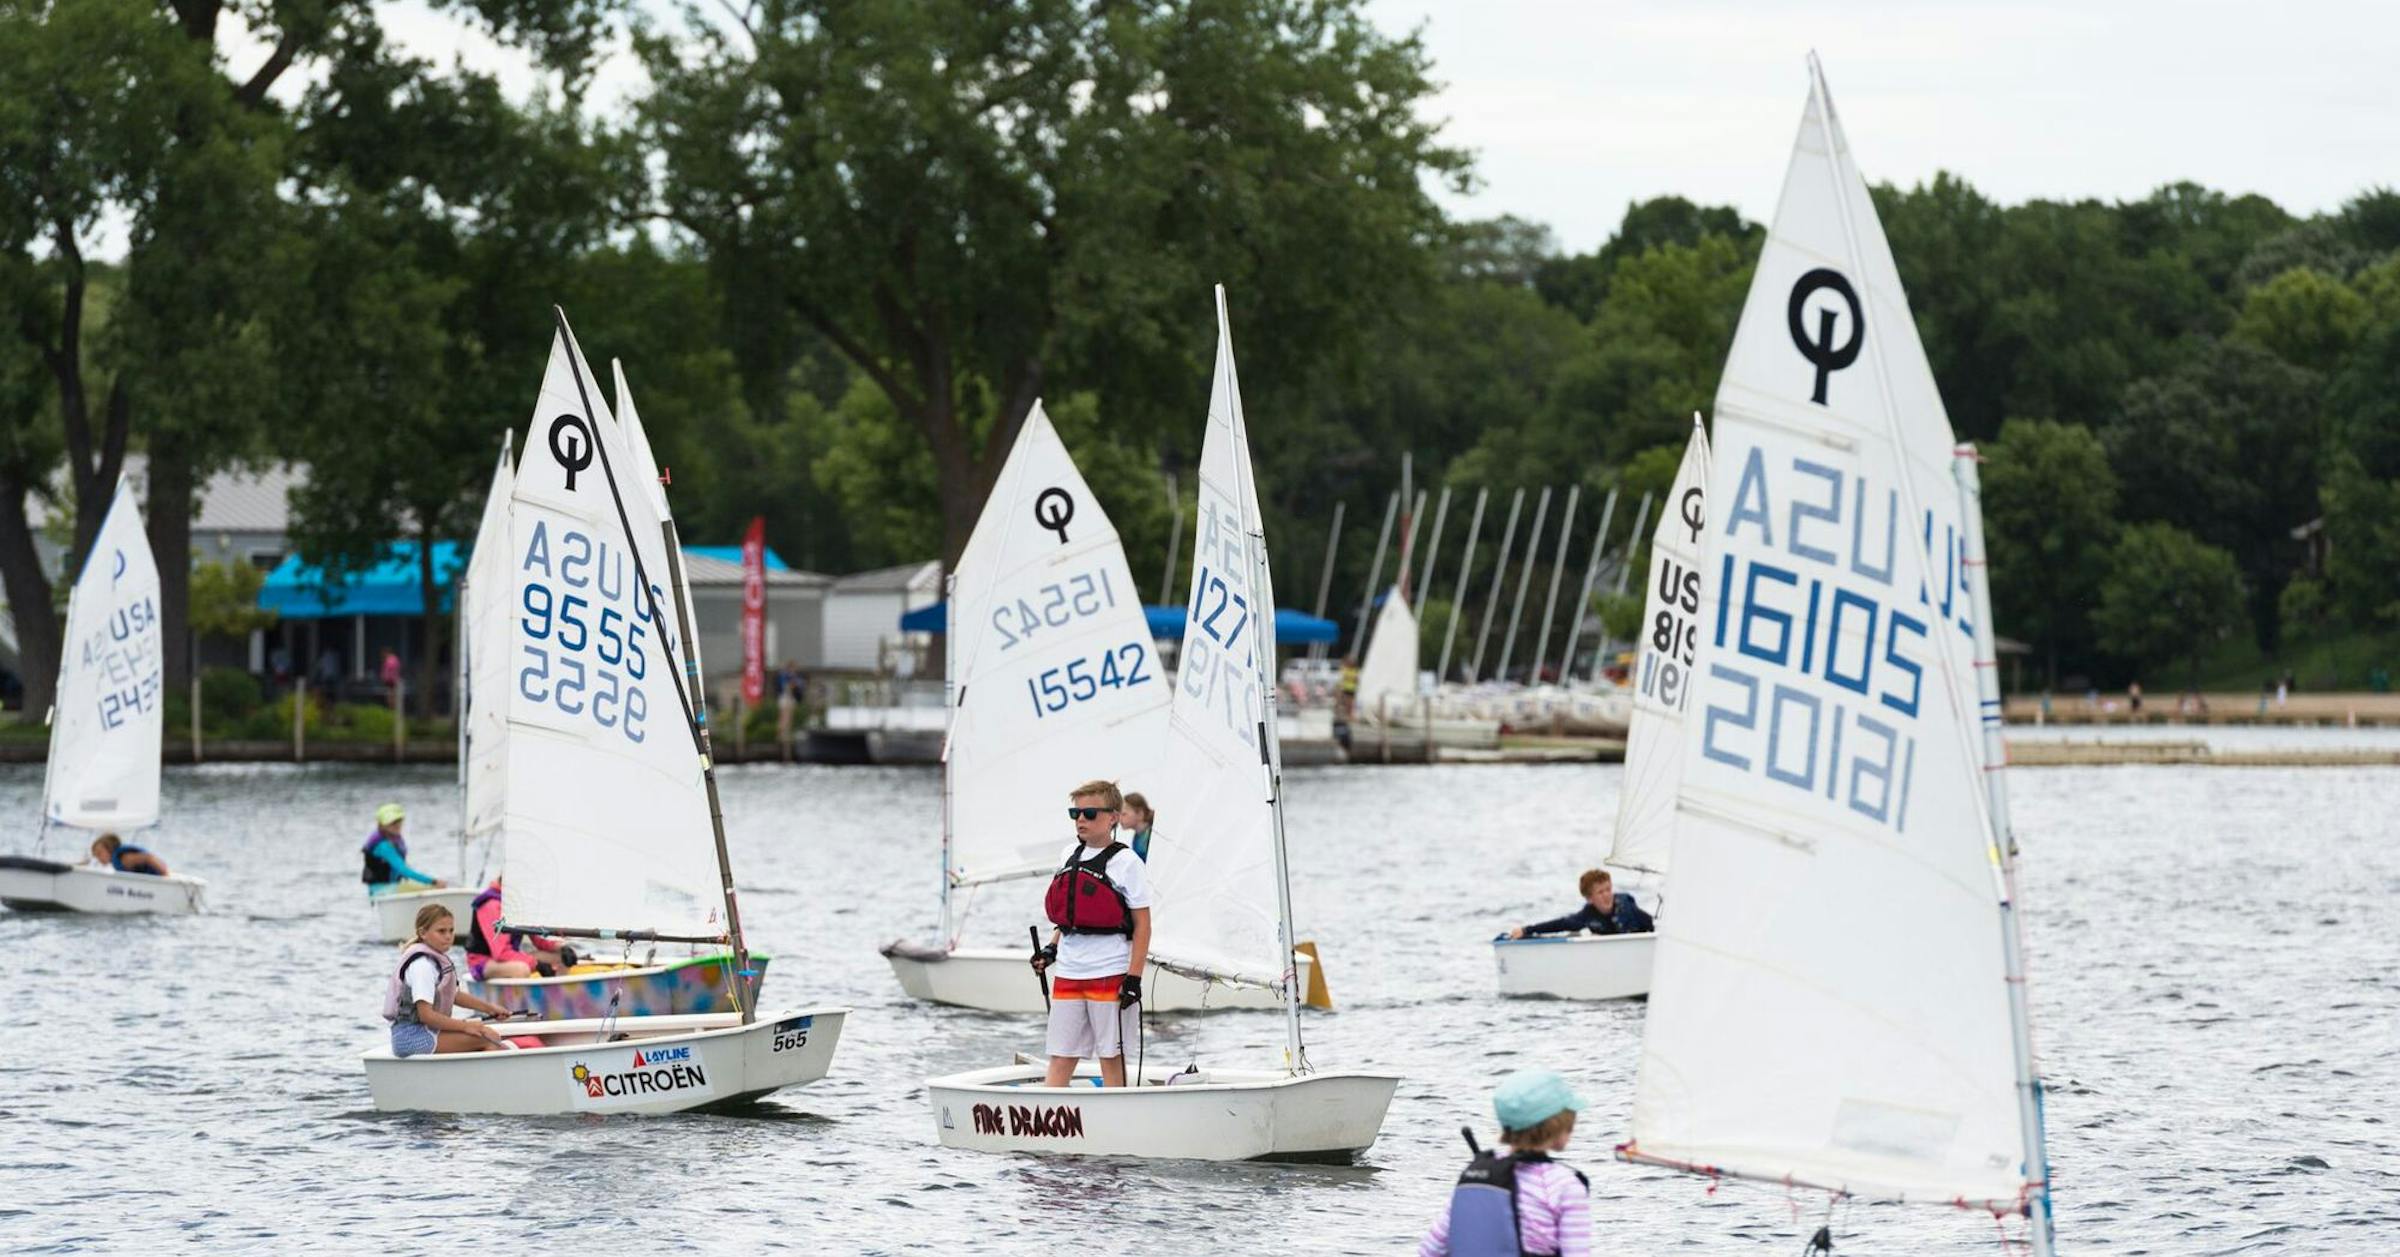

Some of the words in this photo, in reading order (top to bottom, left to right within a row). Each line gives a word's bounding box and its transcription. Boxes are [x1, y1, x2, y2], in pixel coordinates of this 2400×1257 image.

[110, 596, 155, 641] USA
[522, 583, 645, 681] 9555
[1715, 553, 1927, 719] 16105
[1028, 643, 1151, 718] 15542
[645, 1047, 691, 1062] LAYLINE
[773, 1031, 807, 1052] 565
[604, 1063, 706, 1096] CITROËN
[972, 1103, 1005, 1135] FIRE
[1008, 1104, 1084, 1138] DRAGON
